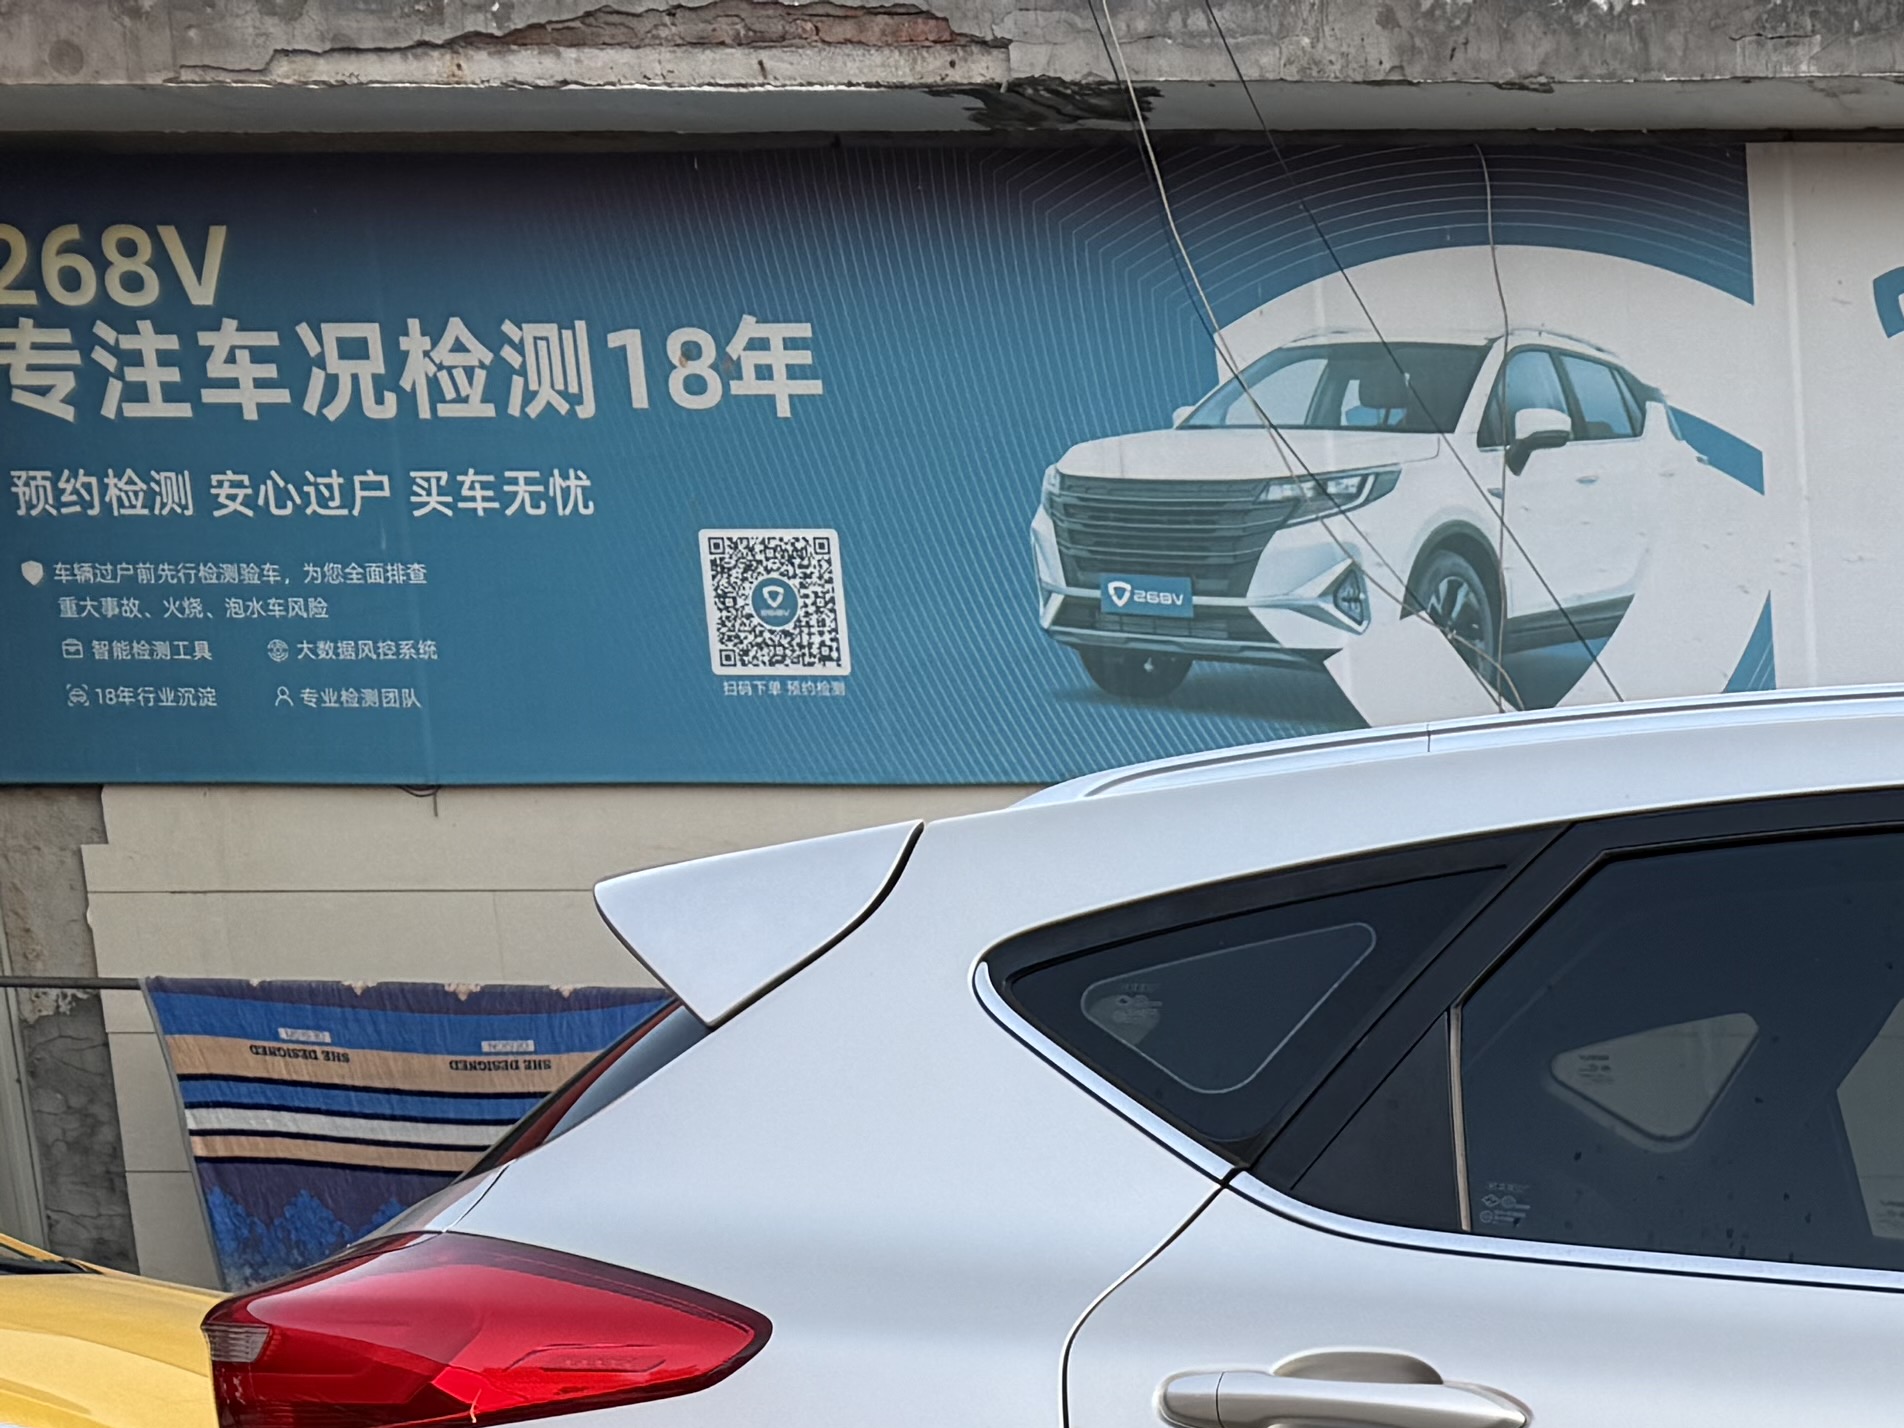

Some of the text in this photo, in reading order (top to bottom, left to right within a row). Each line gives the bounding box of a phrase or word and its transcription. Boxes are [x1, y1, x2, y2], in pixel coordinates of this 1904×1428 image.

[0, 223, 227, 307] 268V
[0, 314, 823, 422] 专注车况检测18年
[10, 468, 595, 517] 预约检测 安心过户 买车无忧
[58, 596, 329, 619] 重大事故、火烧、泡水车风险
[1133, 589, 1184, 606] 268V
[91, 639, 213, 661] 智能检测工具
[297, 639, 439, 661] 大数据风控系统
[95, 686, 218, 707] 18年行业沉淀
[300, 687, 423, 709] 专业检测团队
[249, 1044, 319, 1061] DESIGNED
[449, 1059, 519, 1071] DESIGNED
